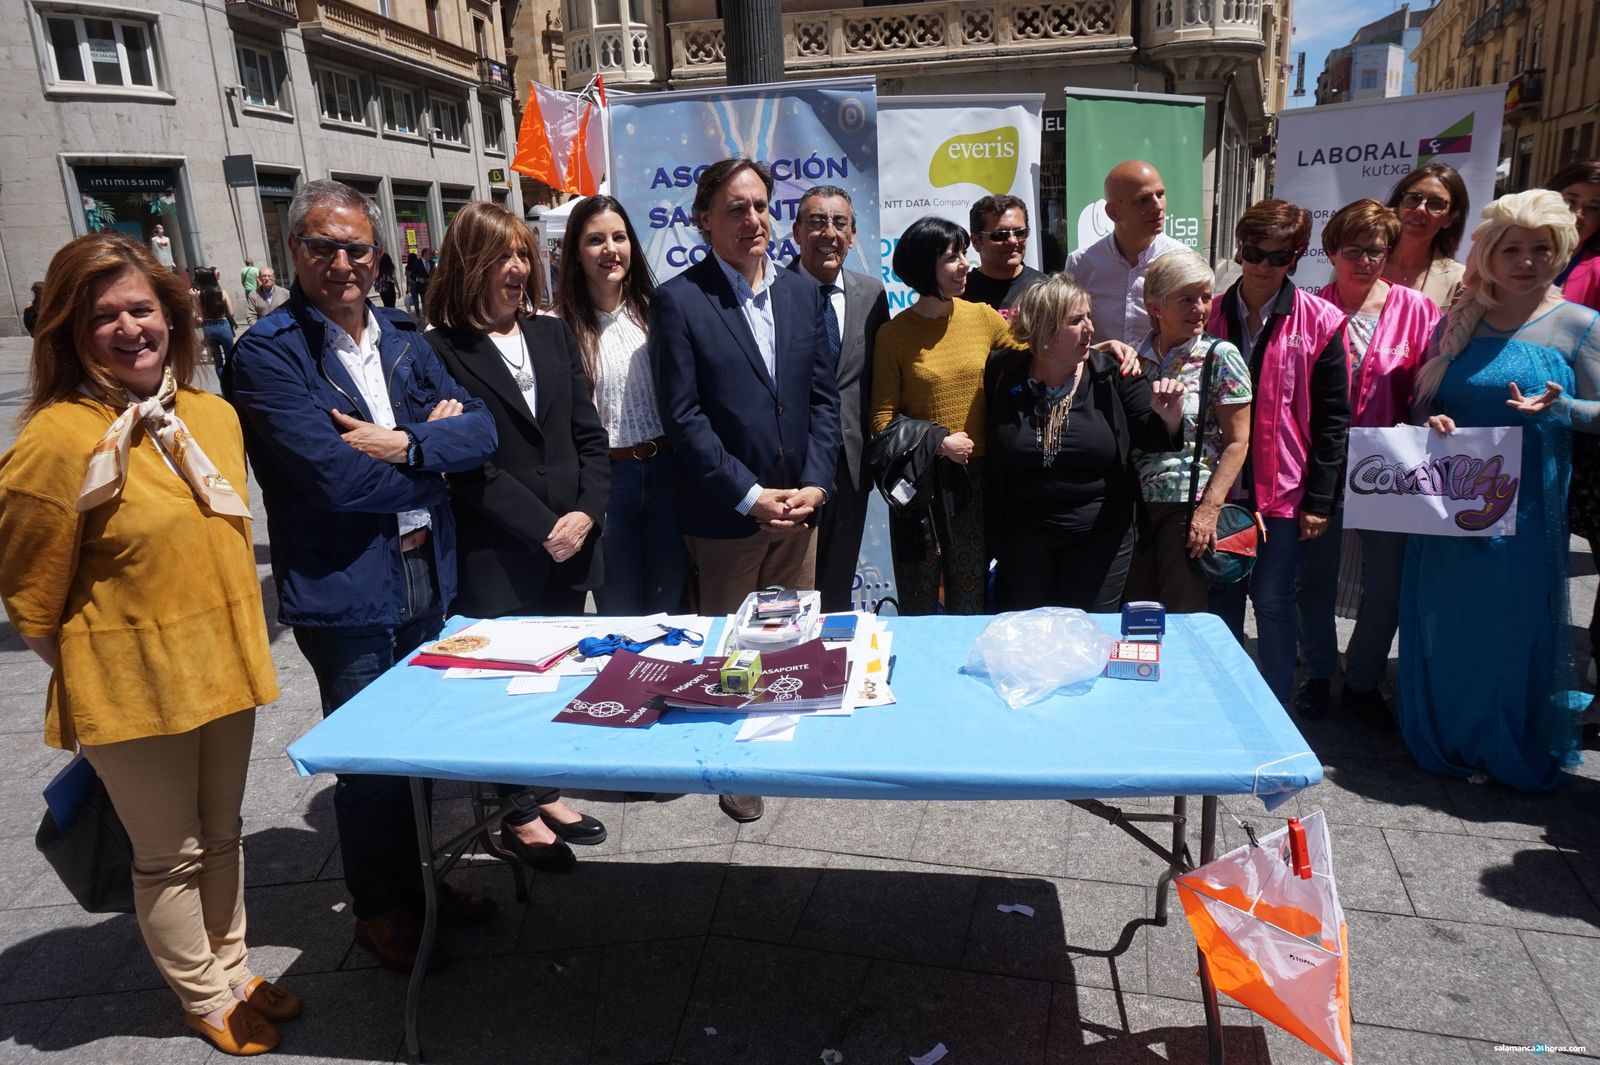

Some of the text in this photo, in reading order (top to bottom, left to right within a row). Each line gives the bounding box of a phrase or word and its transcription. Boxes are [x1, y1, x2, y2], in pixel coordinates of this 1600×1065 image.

[948, 136, 1015, 158] everis
[1297, 140, 1412, 168] LABORAL
[1361, 161, 1411, 178] kutxa
[90, 178, 165, 187] intimissimi
[884, 197, 970, 211] NTT DATA Company
[760, 663, 811, 676] ASAPORTE
